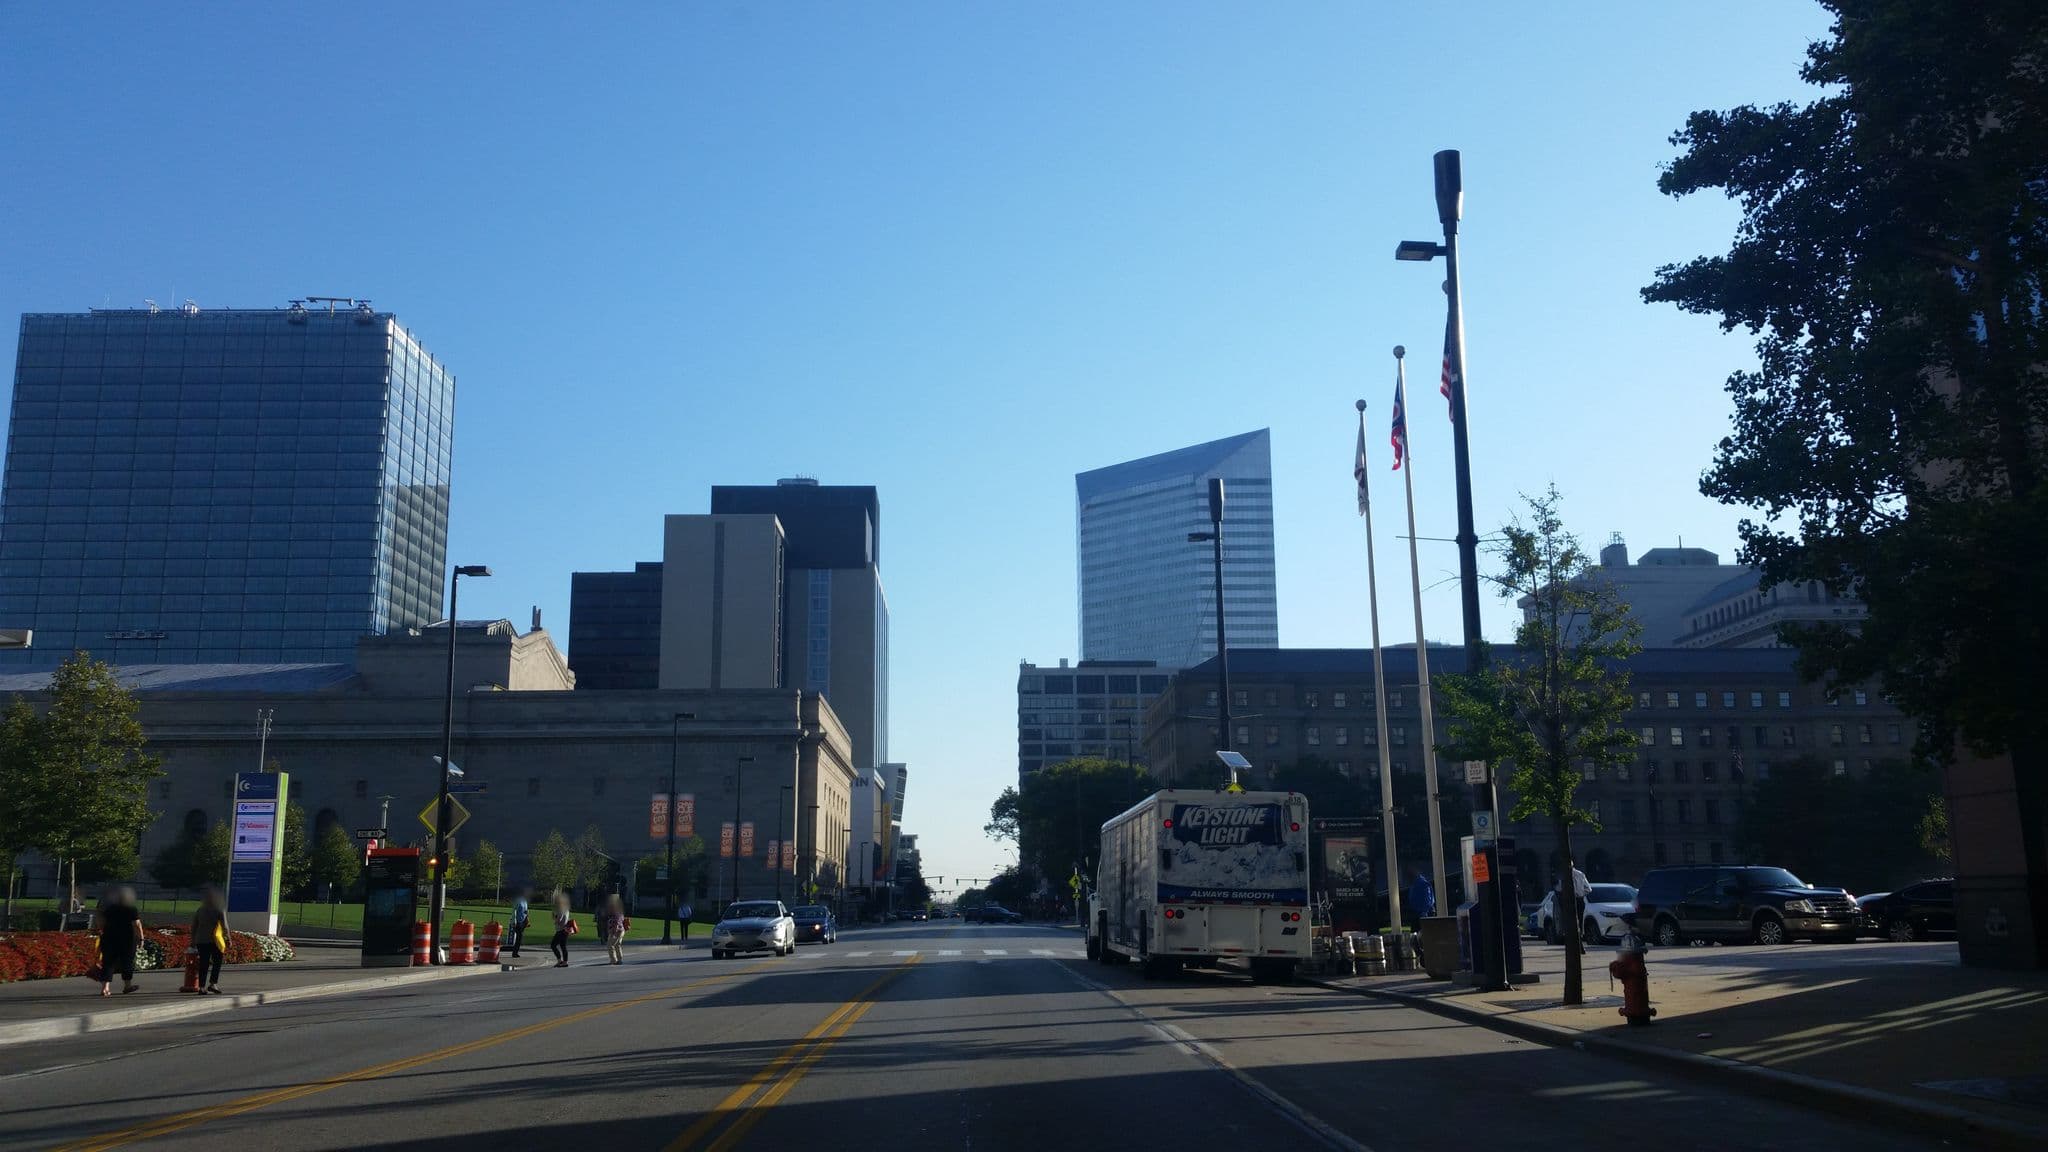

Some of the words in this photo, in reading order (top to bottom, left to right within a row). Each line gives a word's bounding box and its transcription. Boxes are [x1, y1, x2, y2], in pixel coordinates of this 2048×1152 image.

[1179, 806, 1269, 828] KEYSTONE
[1200, 826, 1250, 844] LIGHT
[1190, 890, 1229, 898] ALWAYS
[1231, 890, 1275, 899] SMOOTH
